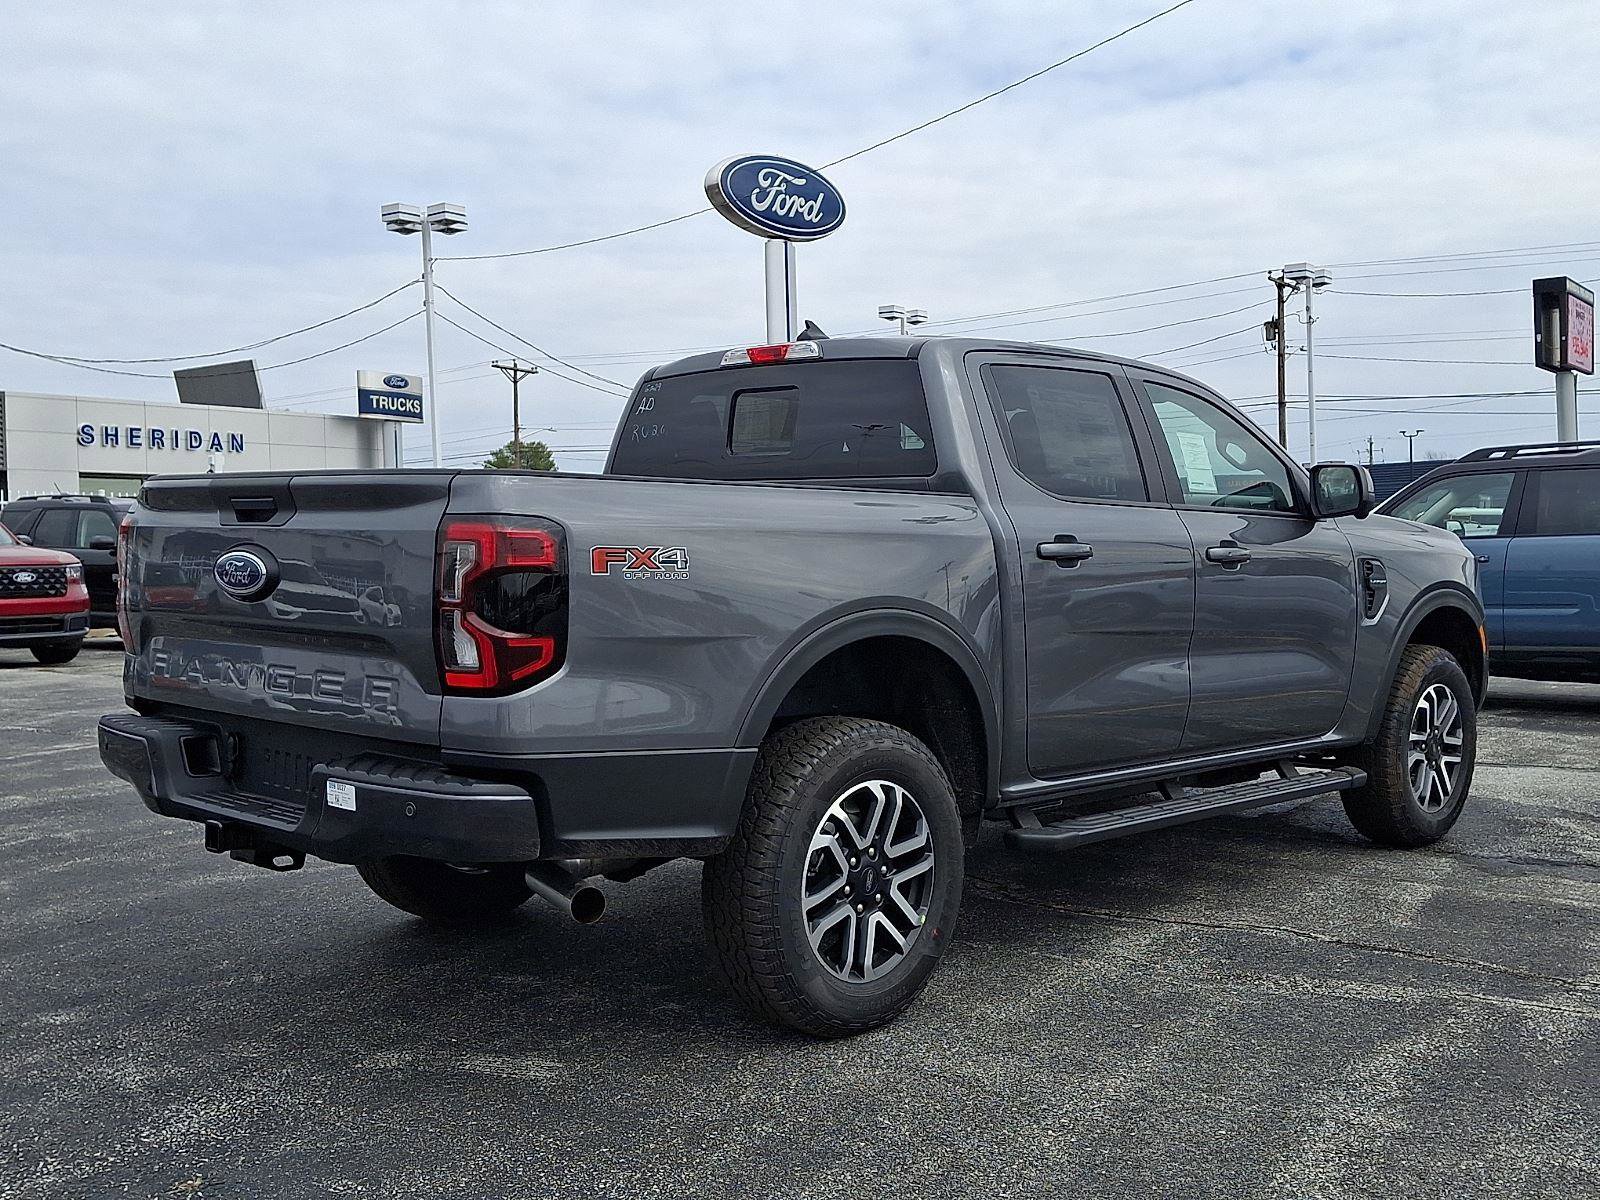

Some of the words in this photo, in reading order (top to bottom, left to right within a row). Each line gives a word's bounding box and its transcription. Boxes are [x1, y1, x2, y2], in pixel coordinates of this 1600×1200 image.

[751, 168, 824, 223] Ford
[369, 394, 421, 413] TRUCKS
[636, 396, 655, 415] AD
[78, 422, 245, 453] SHERIDAN
[222, 560, 251, 584] Ford
[590, 546, 690, 576] FX4
[623, 571, 651, 580] OFF
[654, 571, 690, 580] ROAD
[150, 652, 401, 712] RANGER
